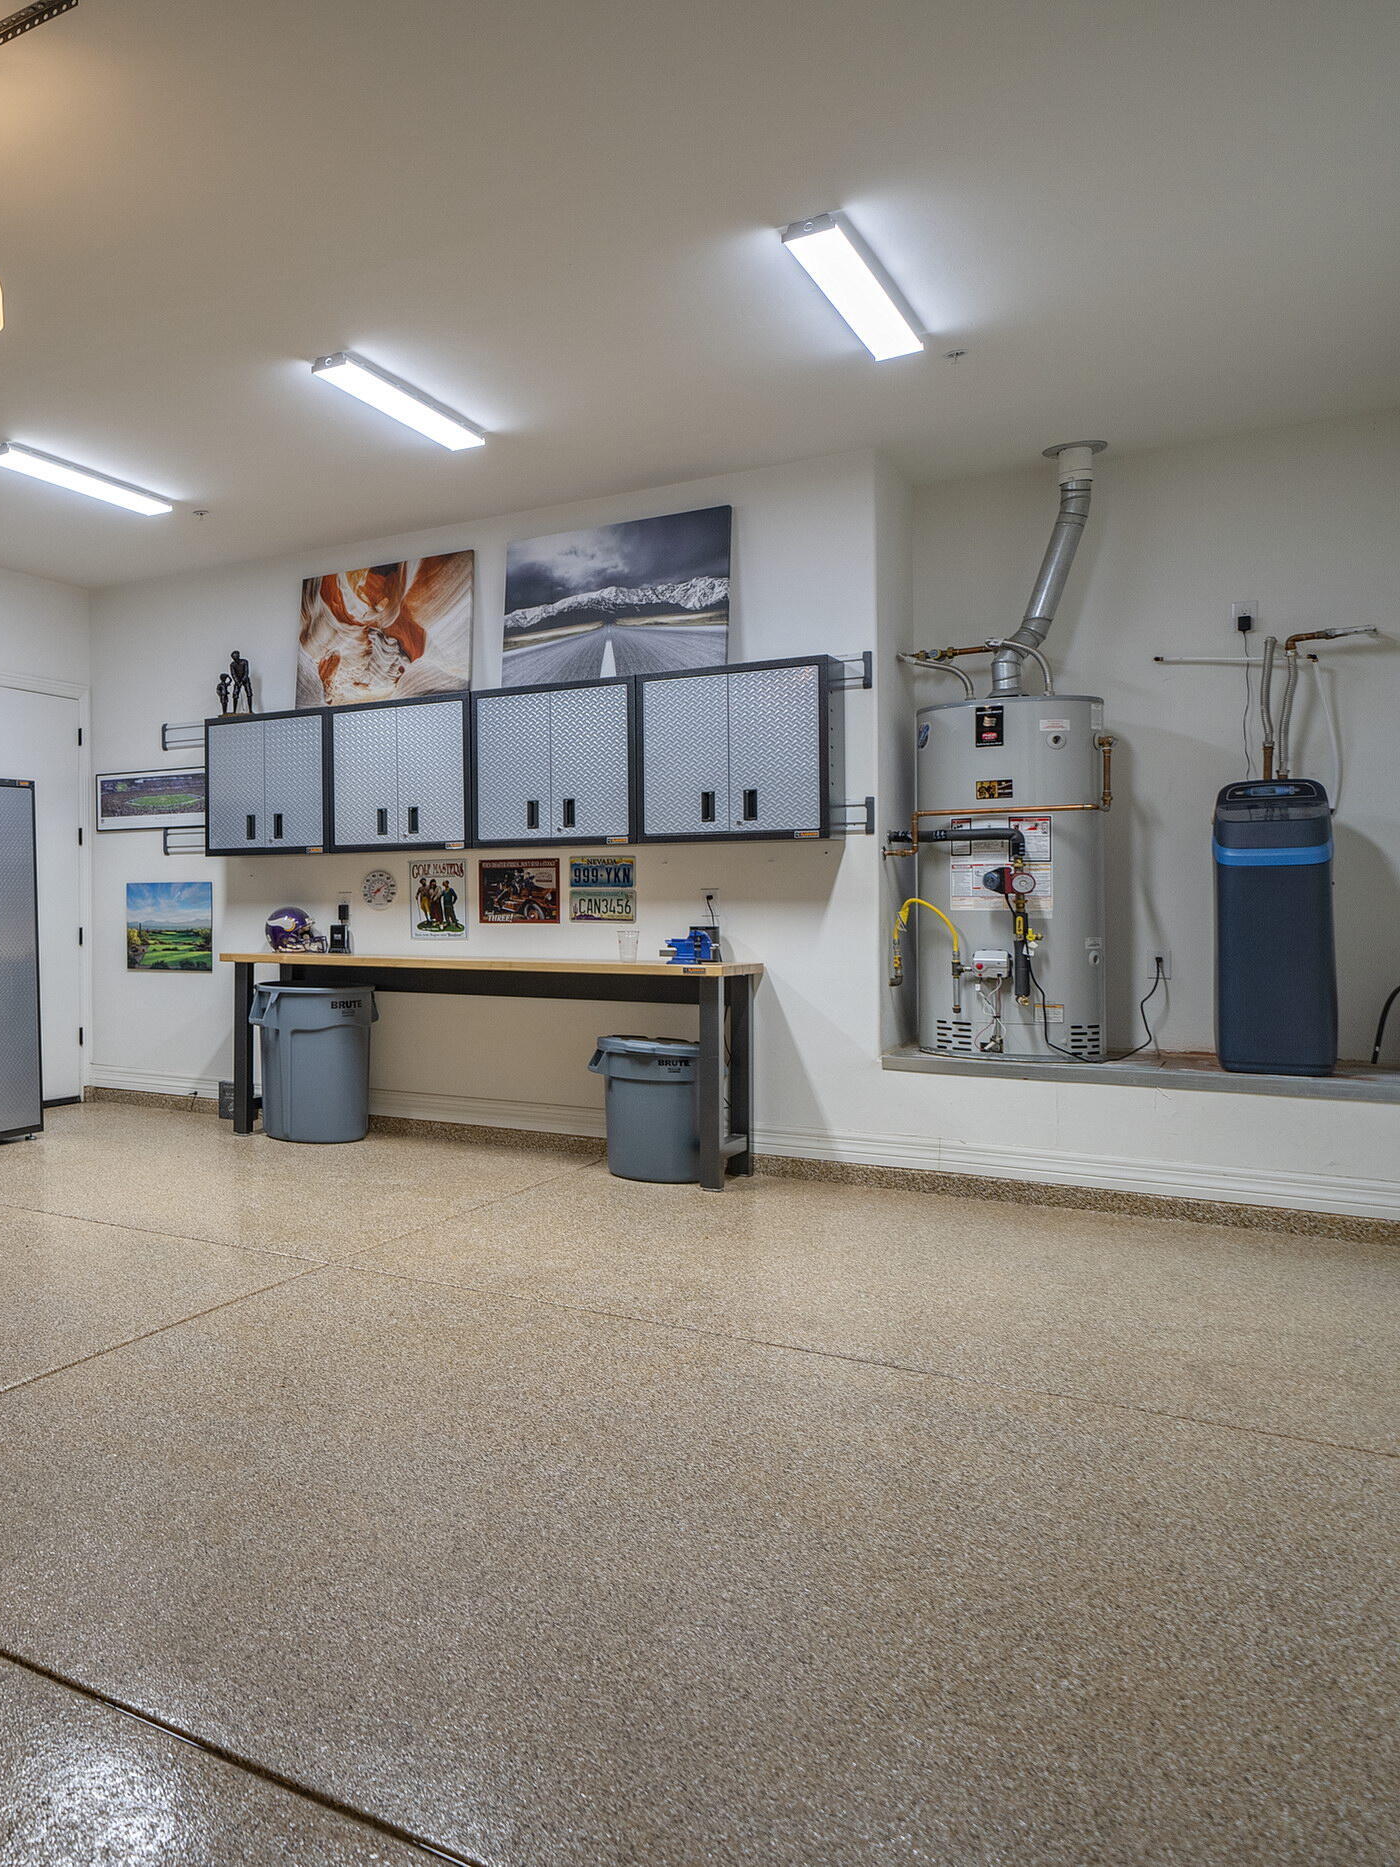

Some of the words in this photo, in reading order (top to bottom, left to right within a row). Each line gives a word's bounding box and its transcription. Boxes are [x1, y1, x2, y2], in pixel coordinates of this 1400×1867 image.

[586, 858, 617, 866] NEVADA
[412, 863, 431, 879] GOLF
[431, 862, 464, 878] MASTERS
[579, 898, 632, 914] CAN3456
[330, 999, 362, 1009] BRUTE
[657, 1059, 692, 1067] BRUTE
